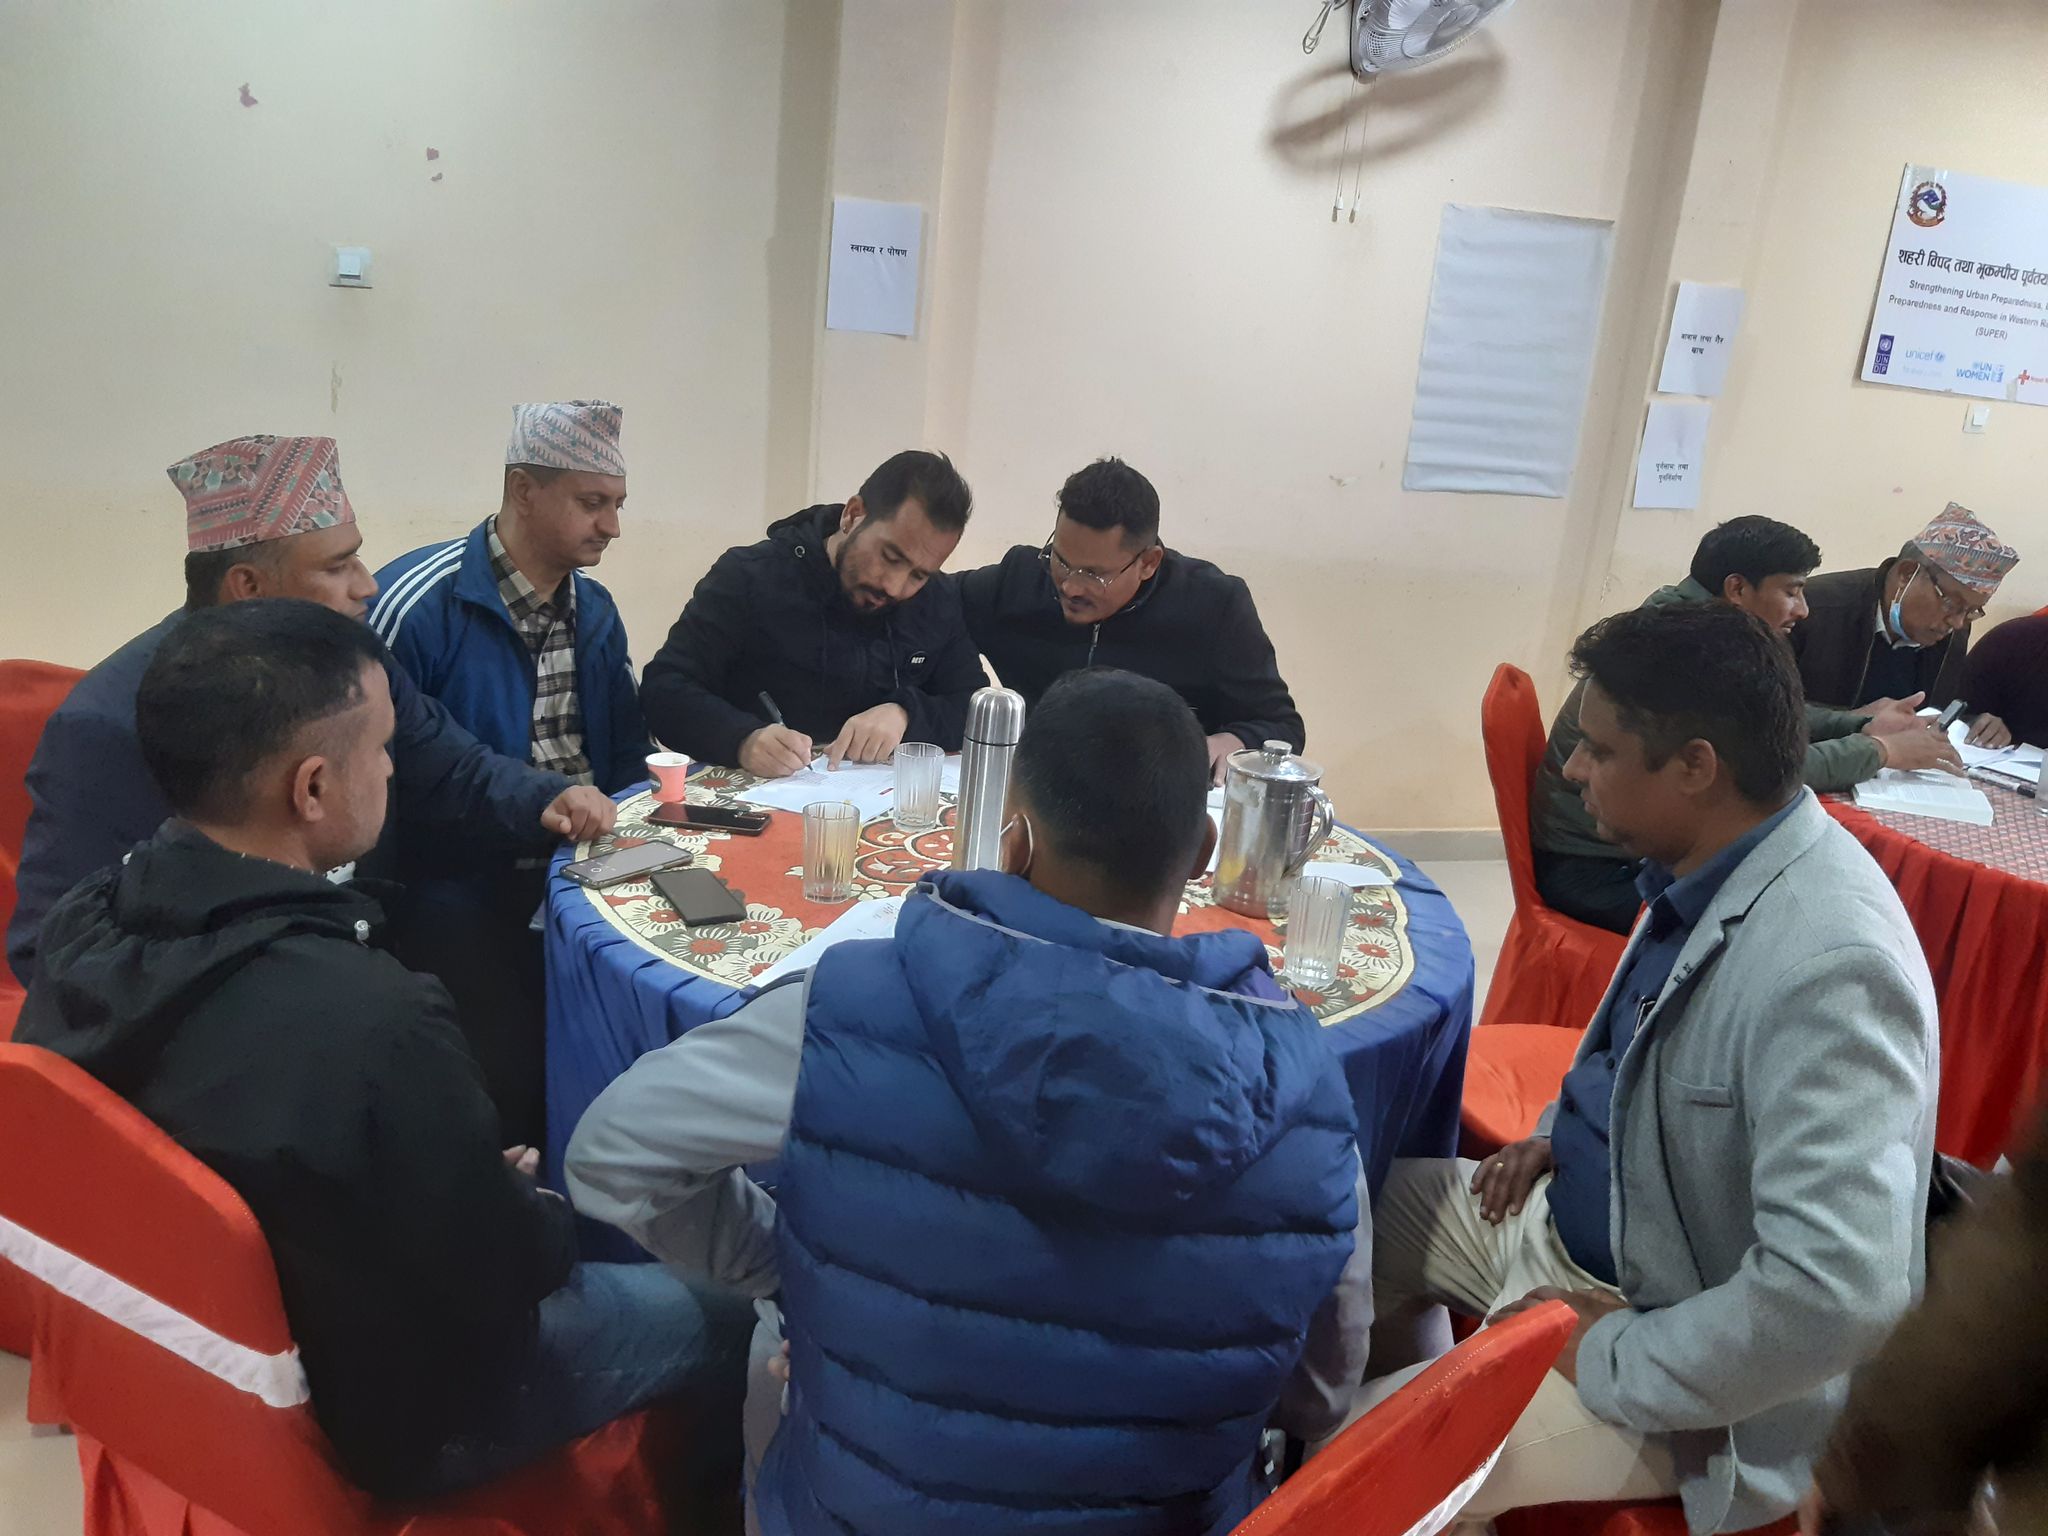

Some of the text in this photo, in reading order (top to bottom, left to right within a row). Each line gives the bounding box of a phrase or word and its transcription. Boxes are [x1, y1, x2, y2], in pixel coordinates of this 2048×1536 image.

[879, 247, 884, 255] र
[887, 246, 907, 257] पोषण
[1898, 249, 1925, 266] शहरी
[1954, 258, 1975, 274] तथा
[1909, 279, 1964, 299] Strengthening
[1965, 288, 1989, 302] Urban
[1888, 294, 1941, 312] Preparedness
[1943, 305, 1959, 314] and
[1960, 305, 1998, 321] Response
[1999, 312, 2007, 321] in
[1975, 326, 2008, 341] (SUPER)
[1905, 349, 1934, 361] unicef
[1980, 362, 1992, 372] UN
[1956, 368, 1990, 381] WOMEN
